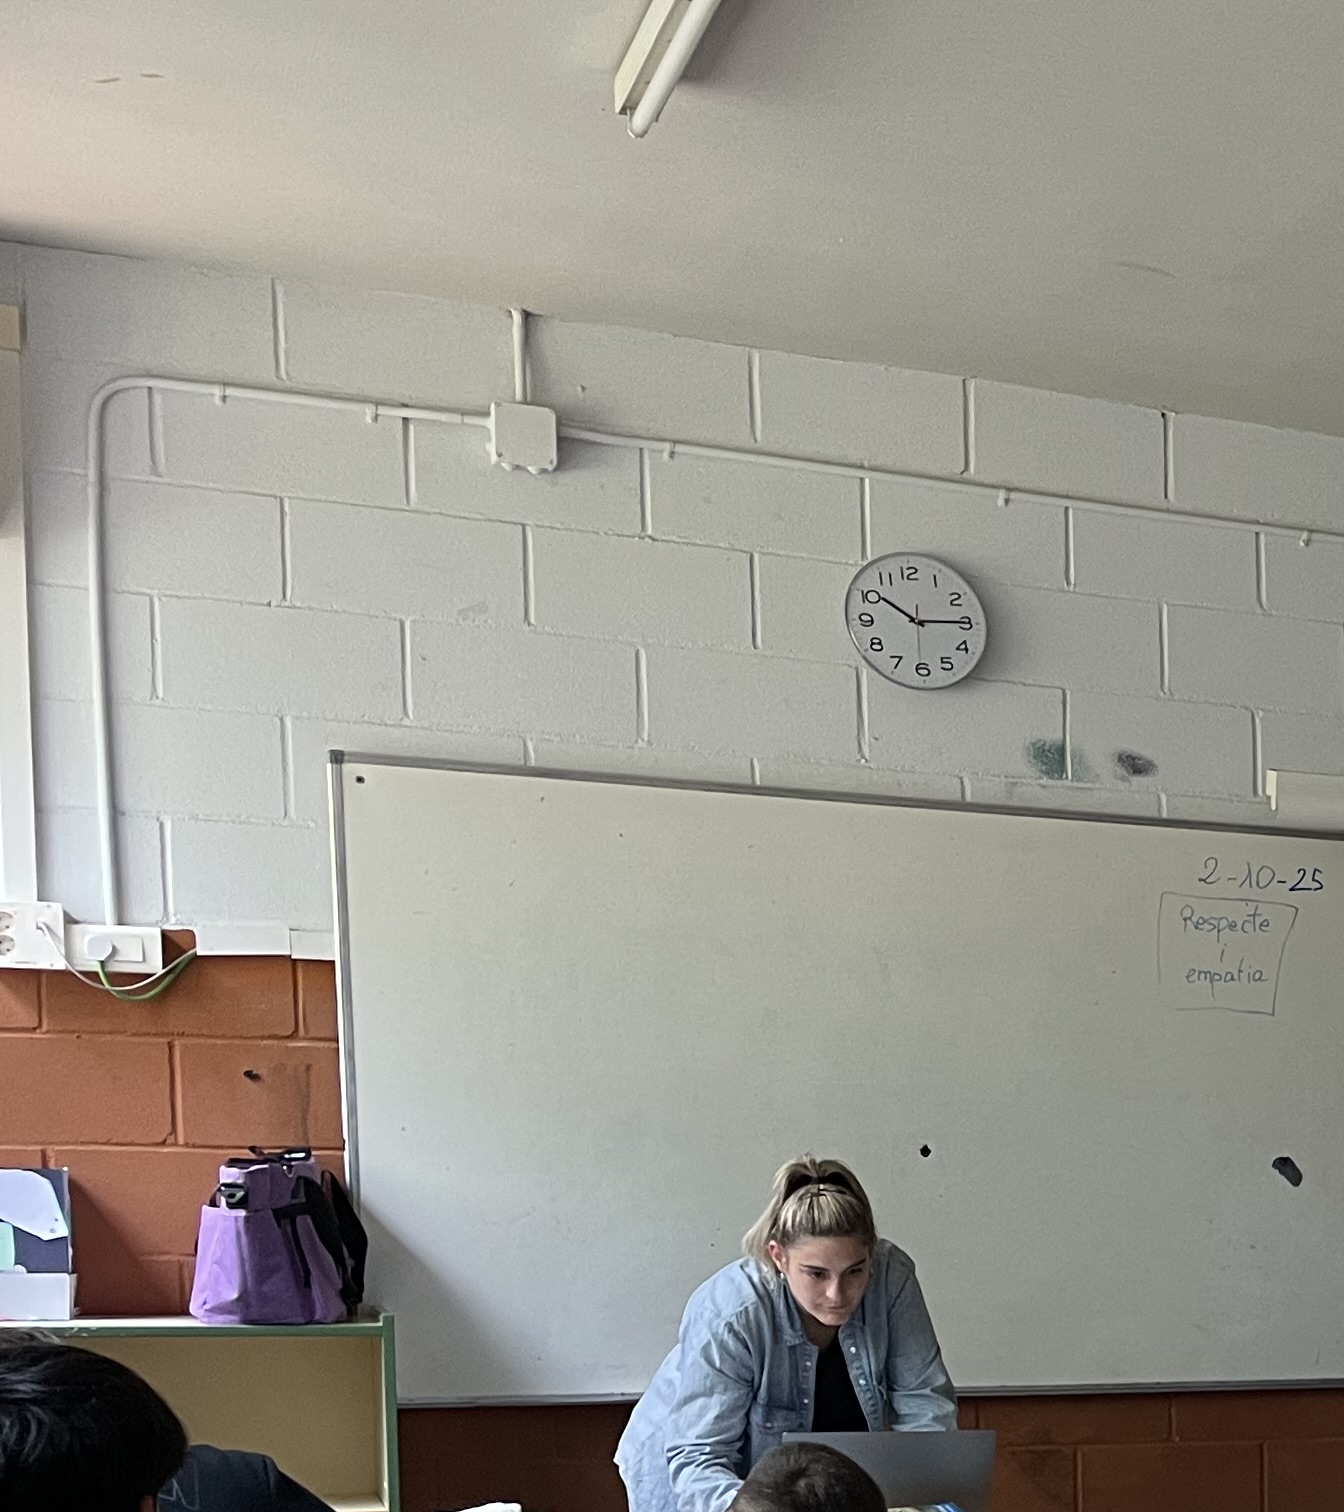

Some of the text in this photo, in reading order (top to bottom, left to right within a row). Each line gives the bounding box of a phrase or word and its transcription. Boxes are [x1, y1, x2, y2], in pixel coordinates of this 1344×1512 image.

[879, 571, 893, 587] 11
[900, 566, 919, 581] 12
[933, 574, 938, 588] 1
[861, 590, 881, 604] 10
[949, 592, 963, 607] 2
[858, 612, 874, 627] 9
[959, 616, 973, 631] 3
[870, 637, 884, 652] 8
[955, 640, 969, 654] 4
[889, 655, 903, 670] 7
[915, 662, 931, 677] 6
[940, 657, 954, 671] 5
[1198, 856, 1324, 892] 2-10-25
[1180, 903, 1271, 944] Respecte
[1220, 943, 1228, 963] i
[1185, 958, 1269, 1002] empatia
